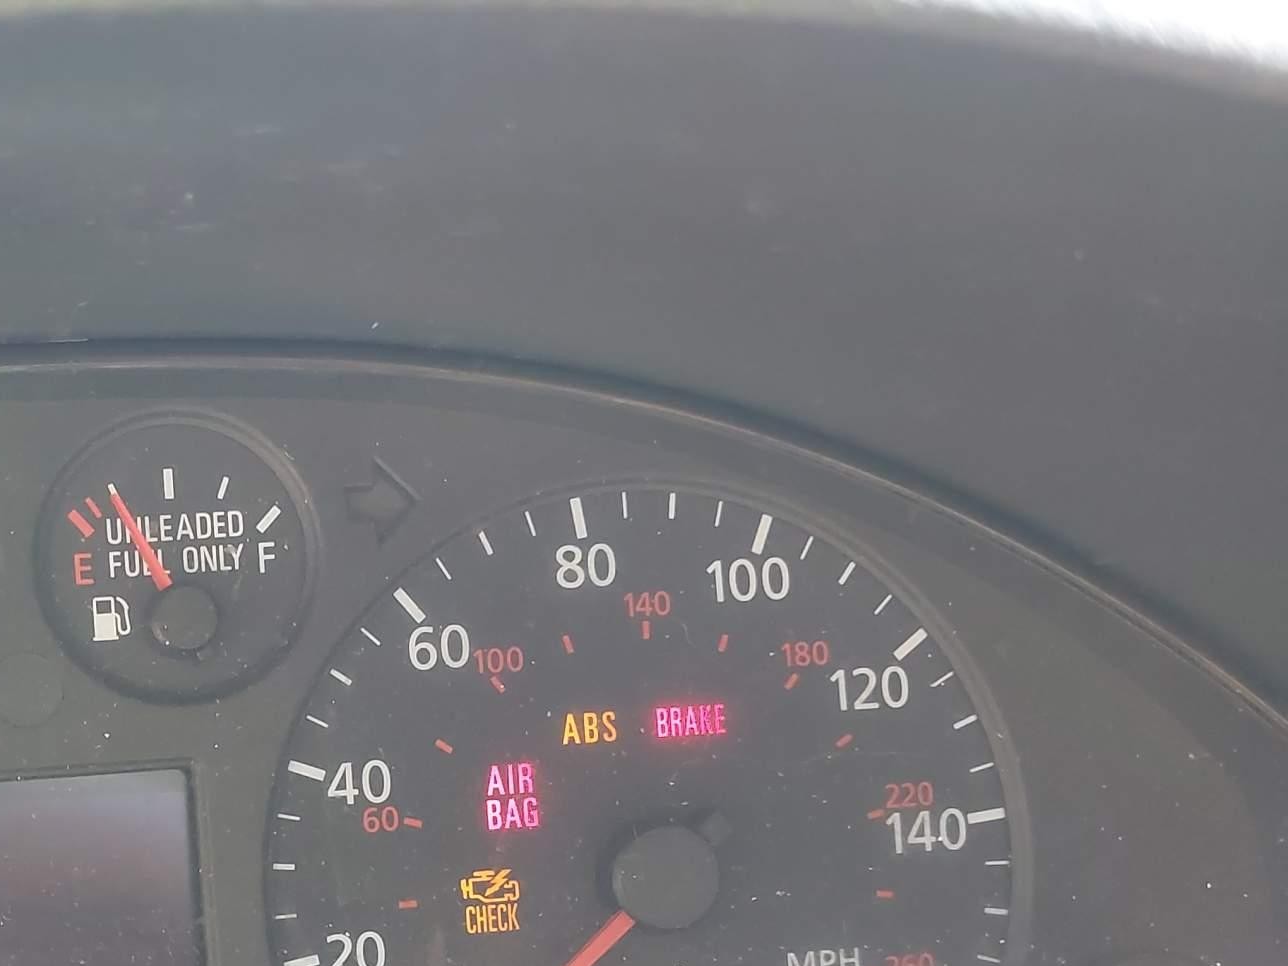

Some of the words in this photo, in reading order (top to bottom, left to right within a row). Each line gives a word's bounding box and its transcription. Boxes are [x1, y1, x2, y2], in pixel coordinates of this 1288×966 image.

[73, 552, 95, 586] E
[182, 543, 244, 574] ONLY
[258, 541, 276, 574] F
[555, 544, 617, 589] 80
[708, 557, 791, 602] 100
[625, 591, 672, 617] 140
[408, 624, 470, 670] 60
[474, 647, 524, 674] 100
[782, 641, 829, 667] 180
[831, 668, 910, 711] 120
[562, 711, 618, 746] ABS
[656, 703, 726, 738] BRAKE
[327, 760, 392, 804] 40
[487, 763, 535, 796] AIR
[885, 781, 934, 808] 220
[363, 806, 399, 833] 60
[486, 797, 540, 830] BAG
[885, 808, 966, 853] 140
[465, 904, 520, 934] CHECK
